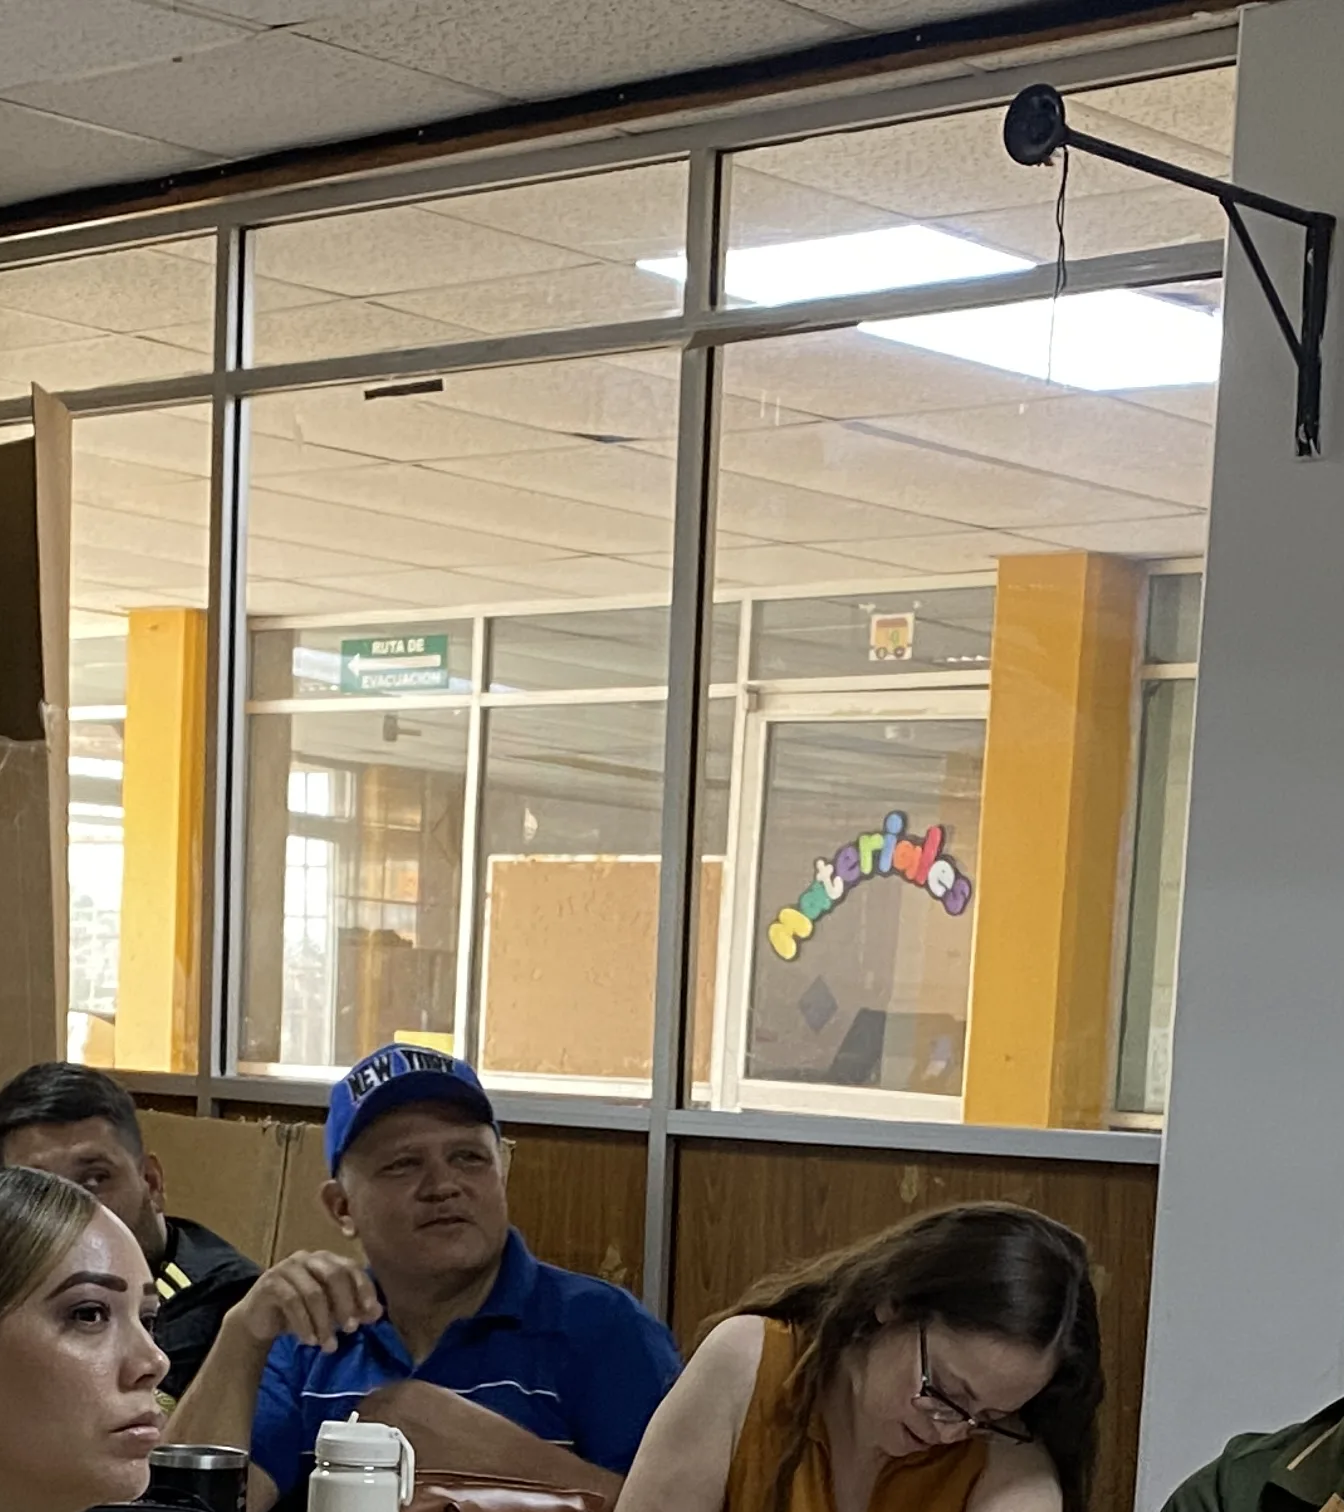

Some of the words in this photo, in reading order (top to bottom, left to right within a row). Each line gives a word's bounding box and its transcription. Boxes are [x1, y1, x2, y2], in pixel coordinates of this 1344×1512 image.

[372, 639, 405, 655] RUTA
[407, 638, 425, 653] DE
[346, 1050, 392, 1103] NEW
